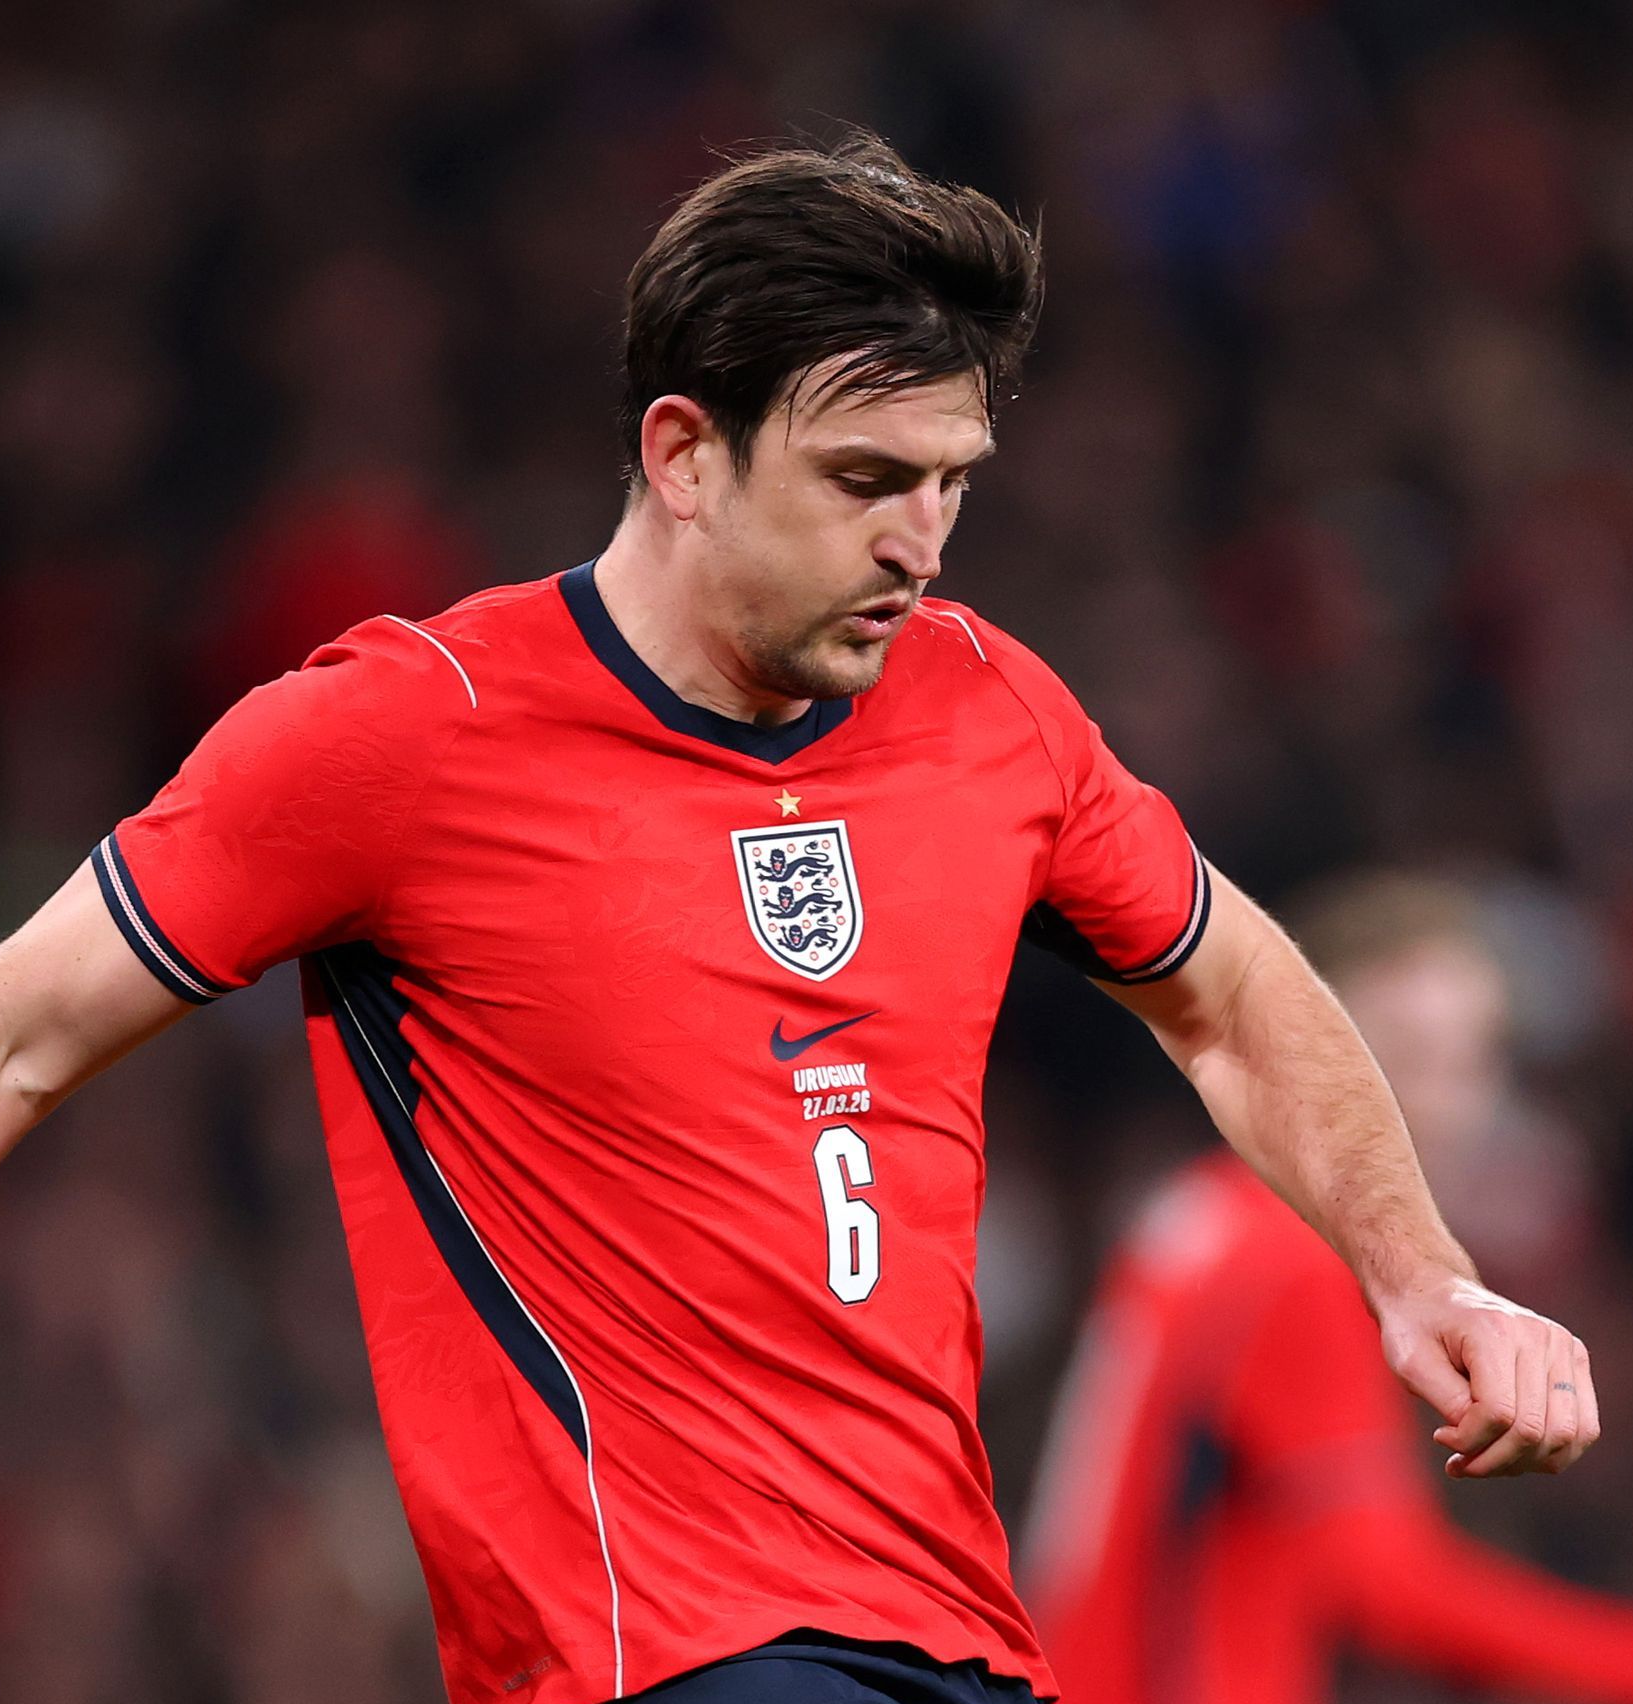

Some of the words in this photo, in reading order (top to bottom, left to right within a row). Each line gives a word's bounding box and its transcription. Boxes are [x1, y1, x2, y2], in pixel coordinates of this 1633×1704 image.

[793, 1063, 867, 1093] URUGUAY
[802, 1089, 871, 1121] 27.03.26
[812, 1123, 881, 1305] 6
